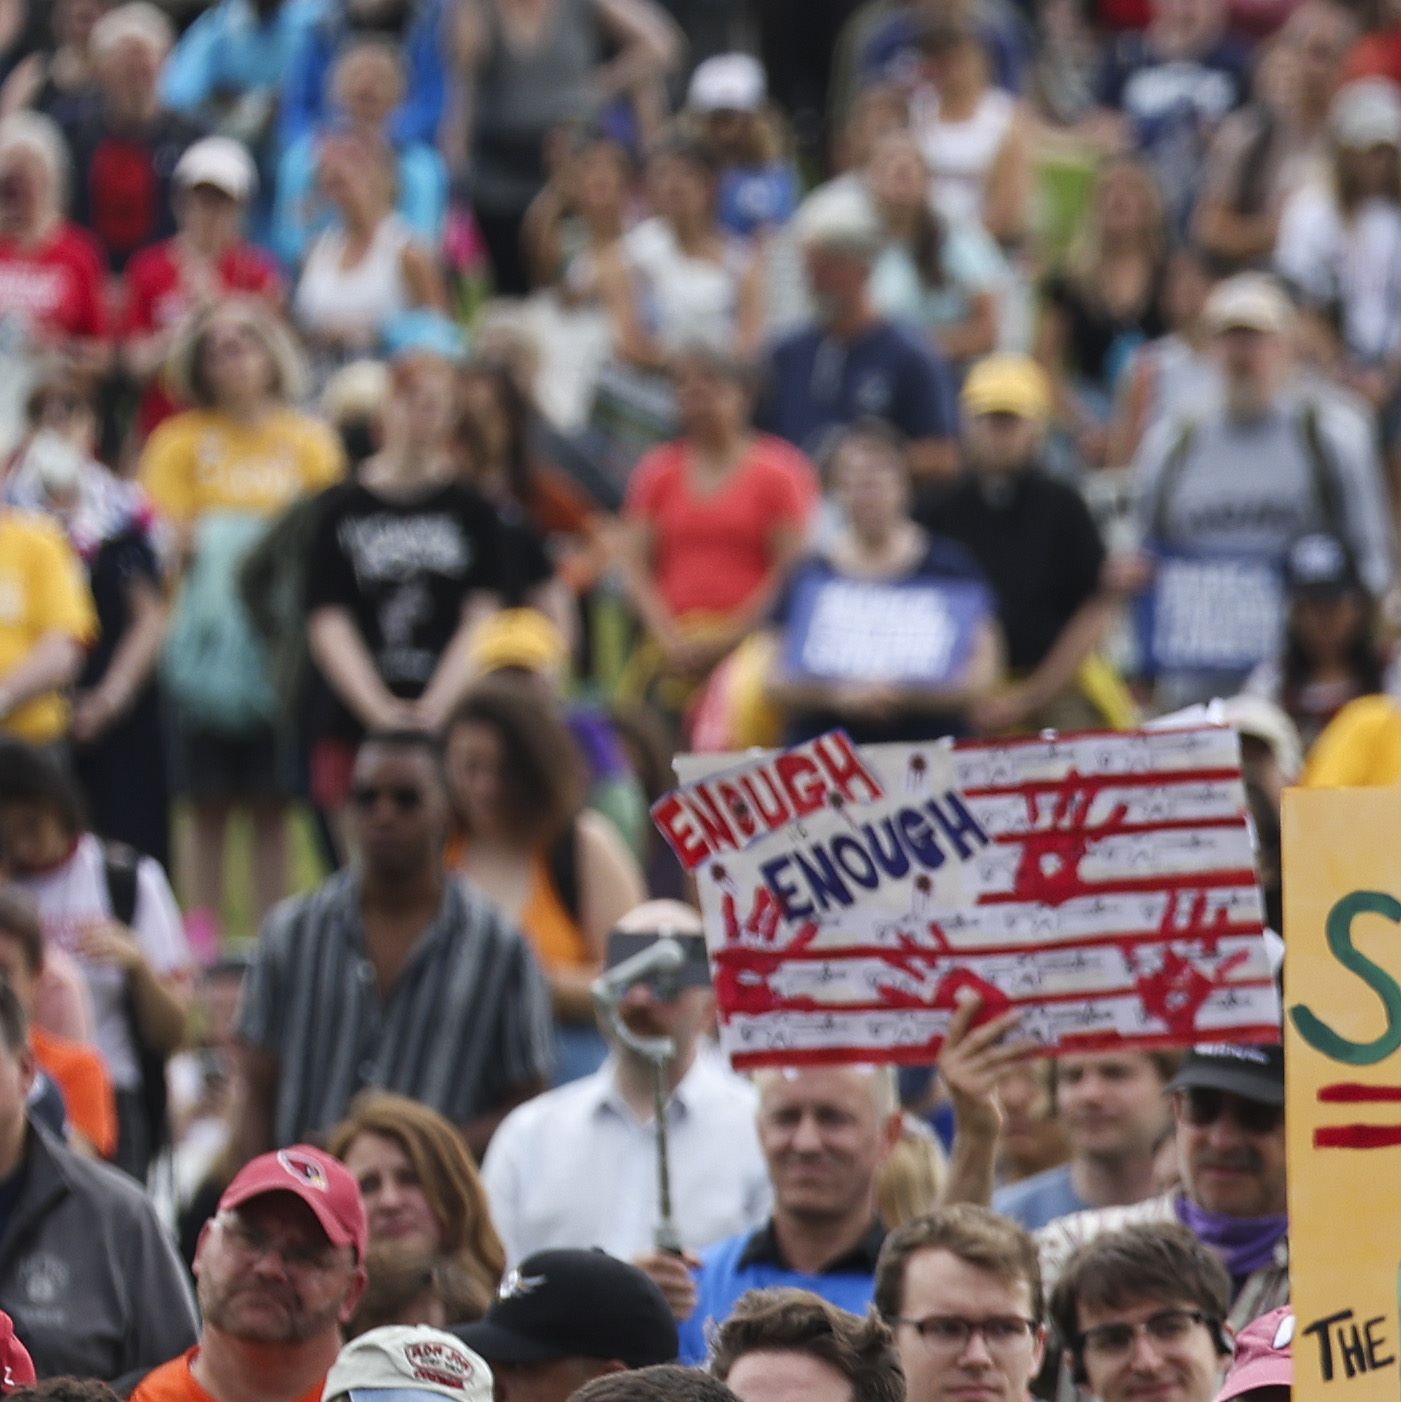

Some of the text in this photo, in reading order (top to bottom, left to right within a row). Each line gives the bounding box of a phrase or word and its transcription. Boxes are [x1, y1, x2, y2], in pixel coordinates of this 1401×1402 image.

[655, 736, 884, 868] ENOUGH
[759, 791, 990, 922] ENOUGH
[1302, 1309, 1396, 1383] THE
